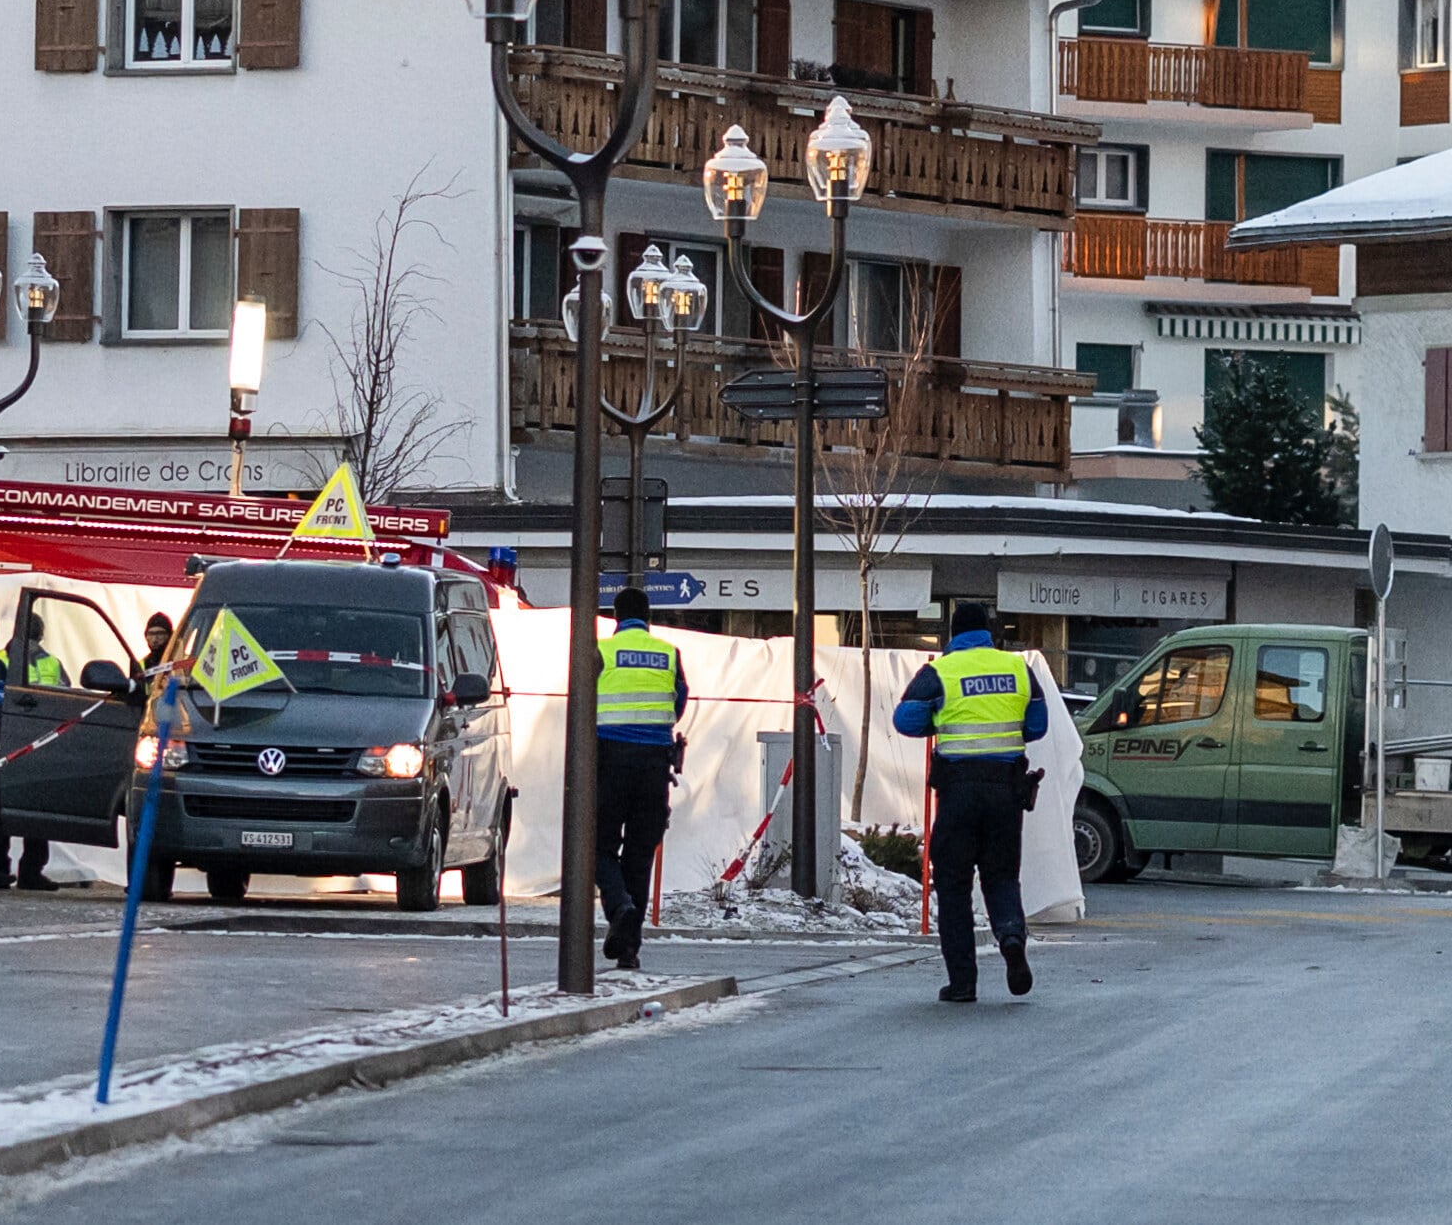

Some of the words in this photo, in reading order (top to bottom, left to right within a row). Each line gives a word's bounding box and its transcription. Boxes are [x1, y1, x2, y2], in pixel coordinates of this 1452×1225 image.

[65, 462, 150, 483] Librairie
[160, 462, 189, 482] de
[325, 497, 344, 512] PC
[316, 515, 348, 527] FRONT
[366, 516, 430, 532] PIERS
[1029, 582, 1081, 605] Librairie
[1141, 589, 1208, 606] CIGARES
[231, 645, 249, 665] PC
[619, 652, 667, 668] POLICE
[231, 660, 258, 681] FRONT
[965, 676, 1015, 694] POLICE
[1112, 739, 1192, 760] EPINEY
